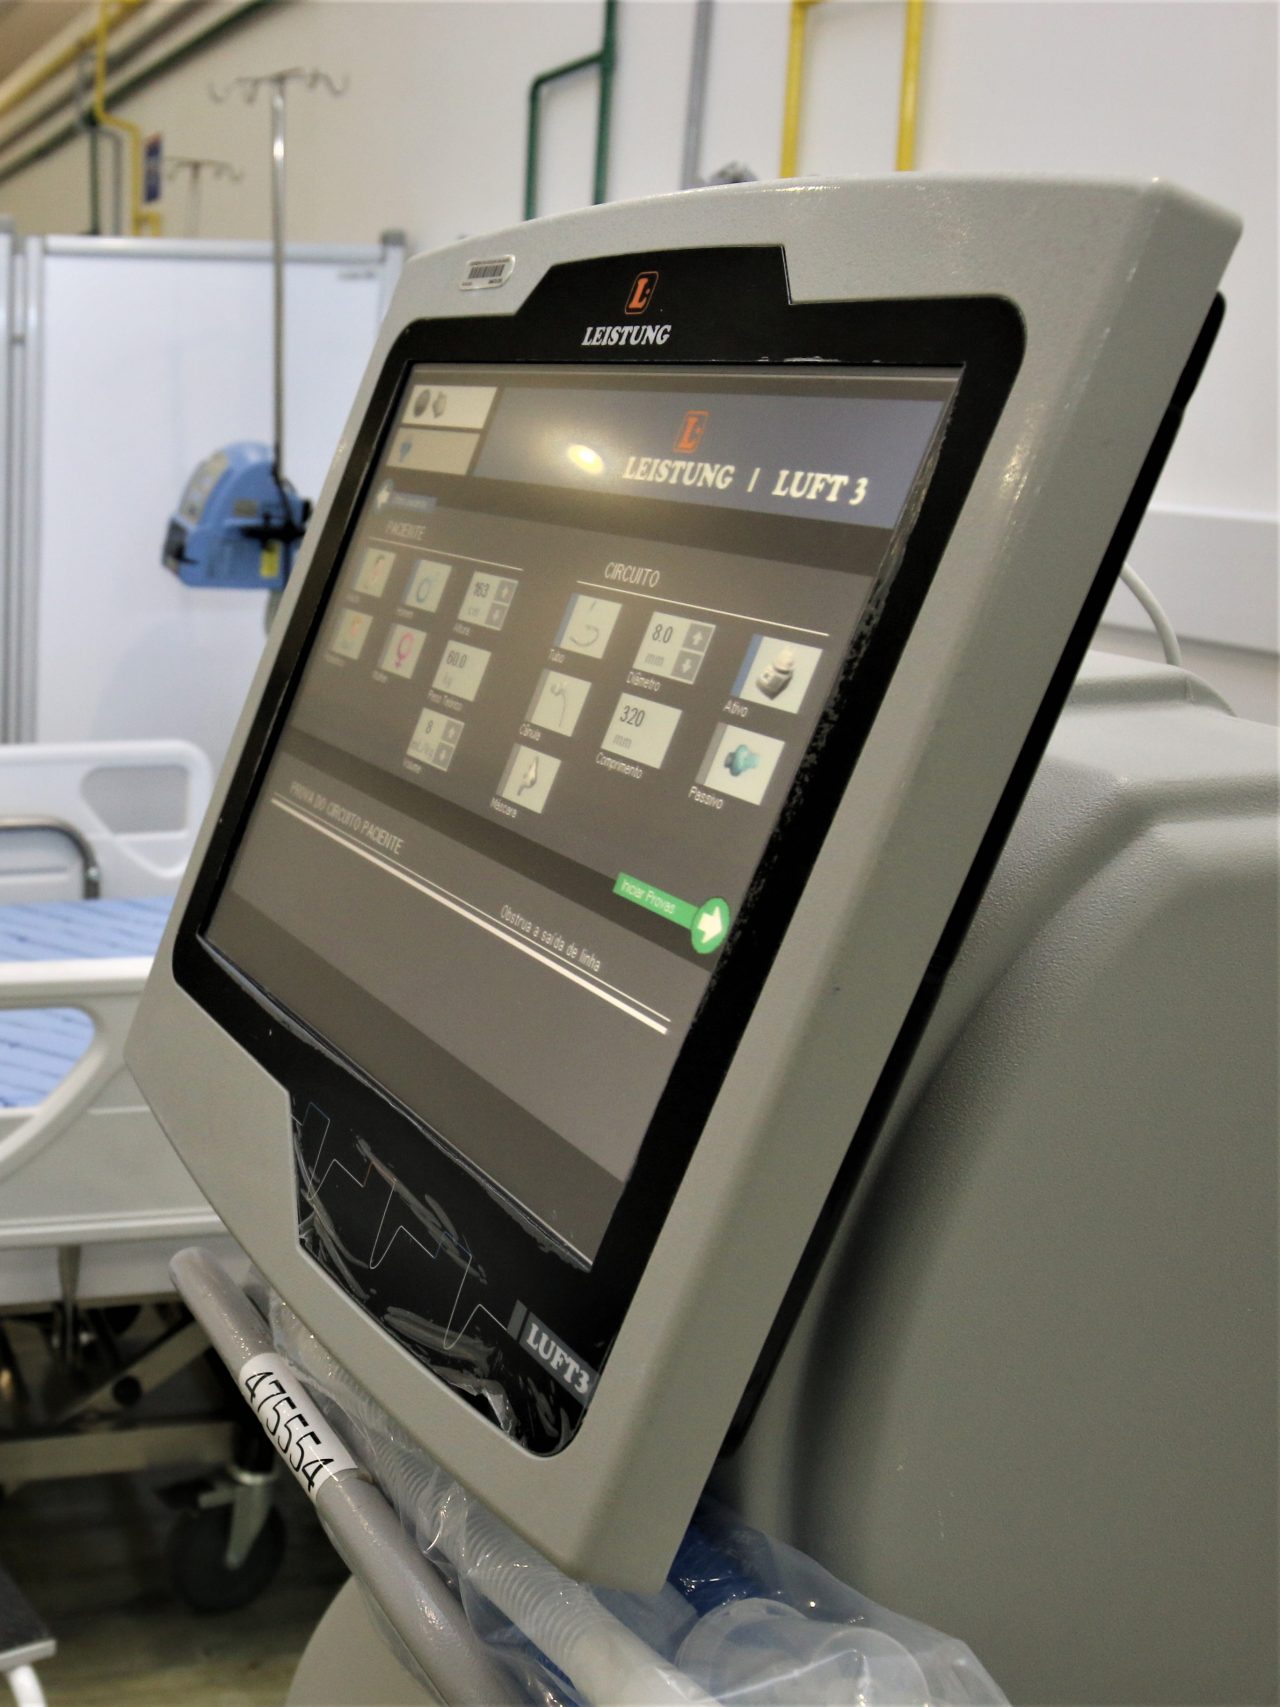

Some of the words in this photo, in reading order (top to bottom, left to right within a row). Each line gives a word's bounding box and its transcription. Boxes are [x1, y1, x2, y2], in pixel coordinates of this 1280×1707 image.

[581, 325, 672, 346] LEISTUNG
[623, 457, 735, 490] LEISTUNG
[772, 470, 849, 502] LUFT
[849, 477, 869, 505] 3
[604, 562, 661, 588] CIRCUITO
[652, 623, 674, 644] 8.0
[619, 705, 646, 728] 320
[722, 700, 750, 718] Ativo
[688, 785, 724, 810] Passivo
[326, 802, 362, 831] CIRCUITO
[360, 820, 404, 855] PACIENTE
[645, 890, 677, 915] Provas
[500, 903, 532, 934] Obstrua
[532, 926, 540, 938] a
[566, 942, 578, 959] de
[578, 947, 601, 972] linha
[525, 1324, 590, 1395] LUFT3
[243, 1370, 334, 1494] 475554
